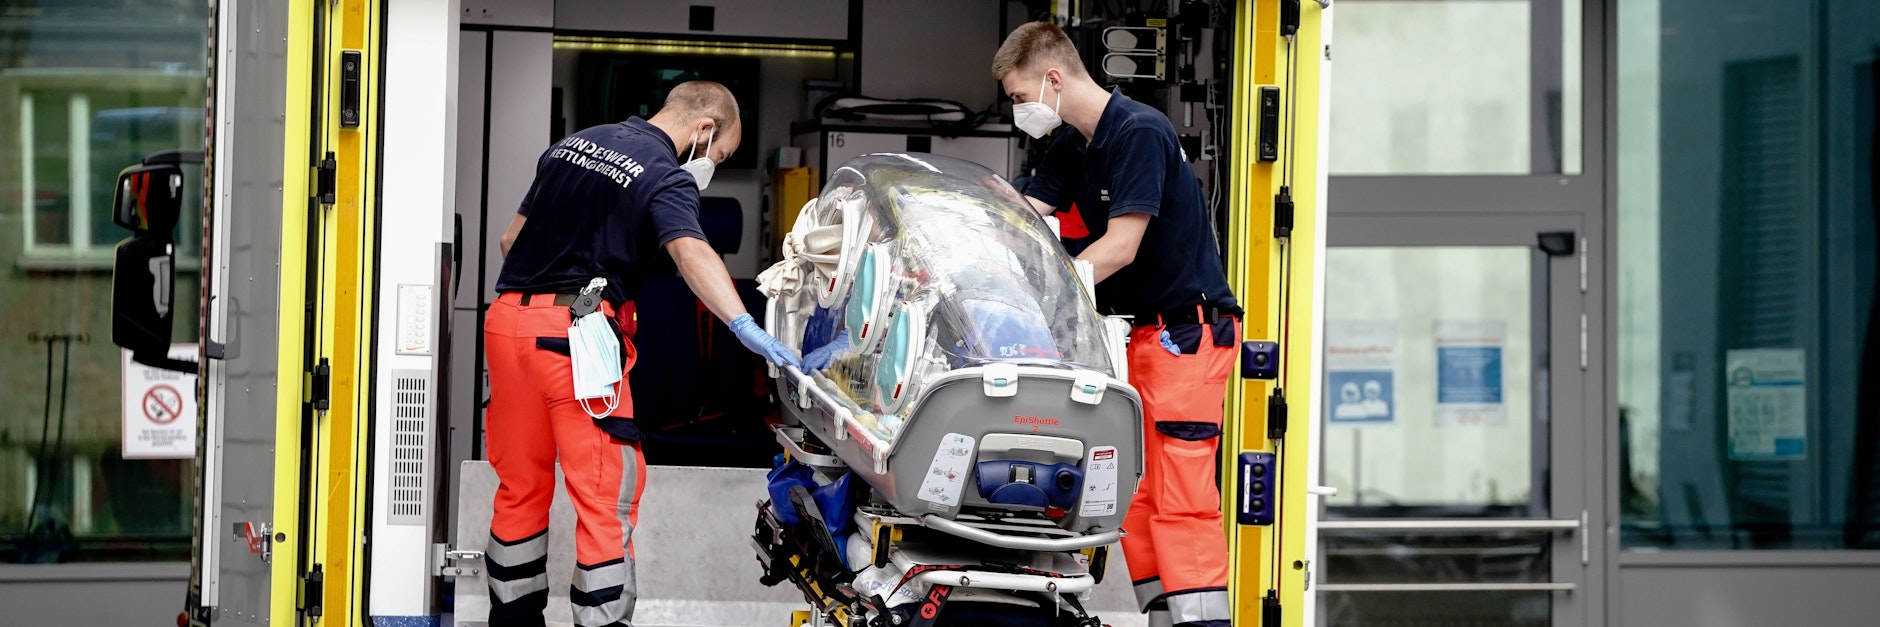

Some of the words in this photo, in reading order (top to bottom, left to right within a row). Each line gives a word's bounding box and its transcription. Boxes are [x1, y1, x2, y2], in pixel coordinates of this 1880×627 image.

[829, 133, 845, 148] 16
[559, 137, 645, 178] BUNDESWEHR
[550, 148, 633, 188] RETTUNGDIENST
[1014, 415, 1060, 426] EpiShuttle
[1032, 425, 1039, 433] 2
